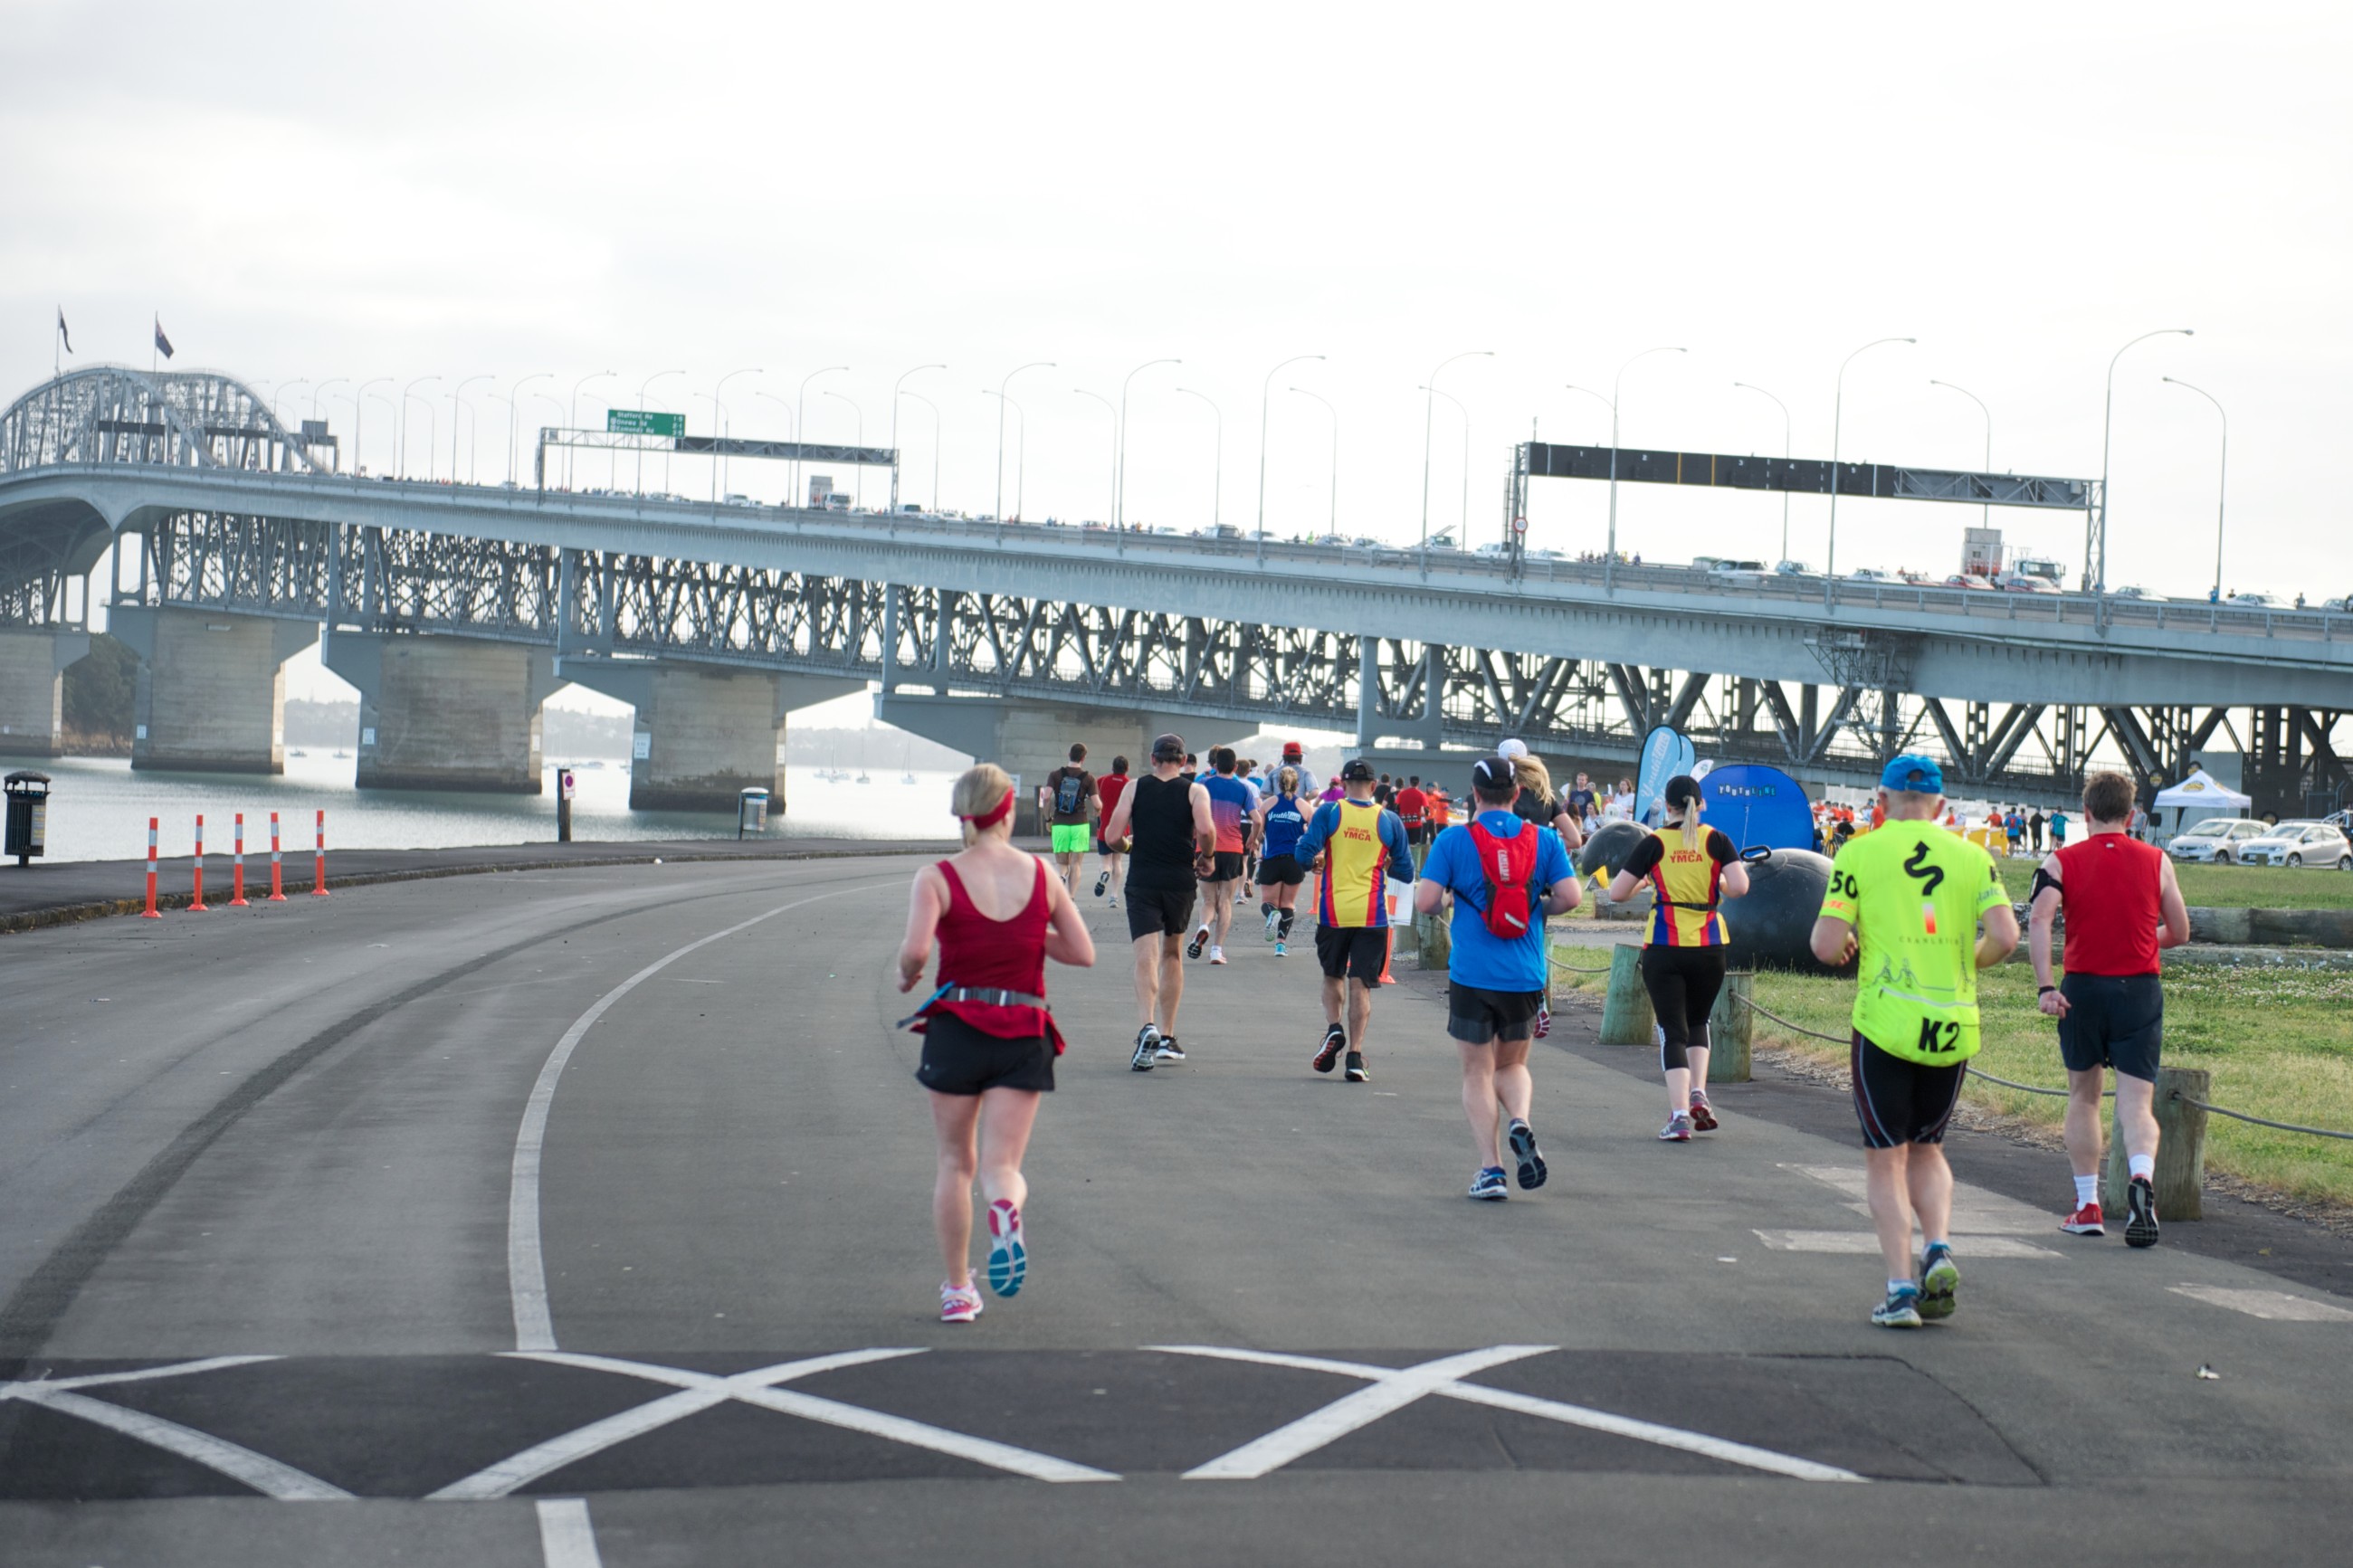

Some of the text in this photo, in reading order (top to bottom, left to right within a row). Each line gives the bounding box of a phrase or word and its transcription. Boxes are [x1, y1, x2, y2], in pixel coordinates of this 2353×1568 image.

[1719, 784, 1776, 796] YOUTHLINE
[1343, 831, 1371, 842] YMCA
[1670, 854, 1703, 863] YMCA
[1830, 870, 1858, 899] 50
[1918, 1016, 1960, 1052] K2
